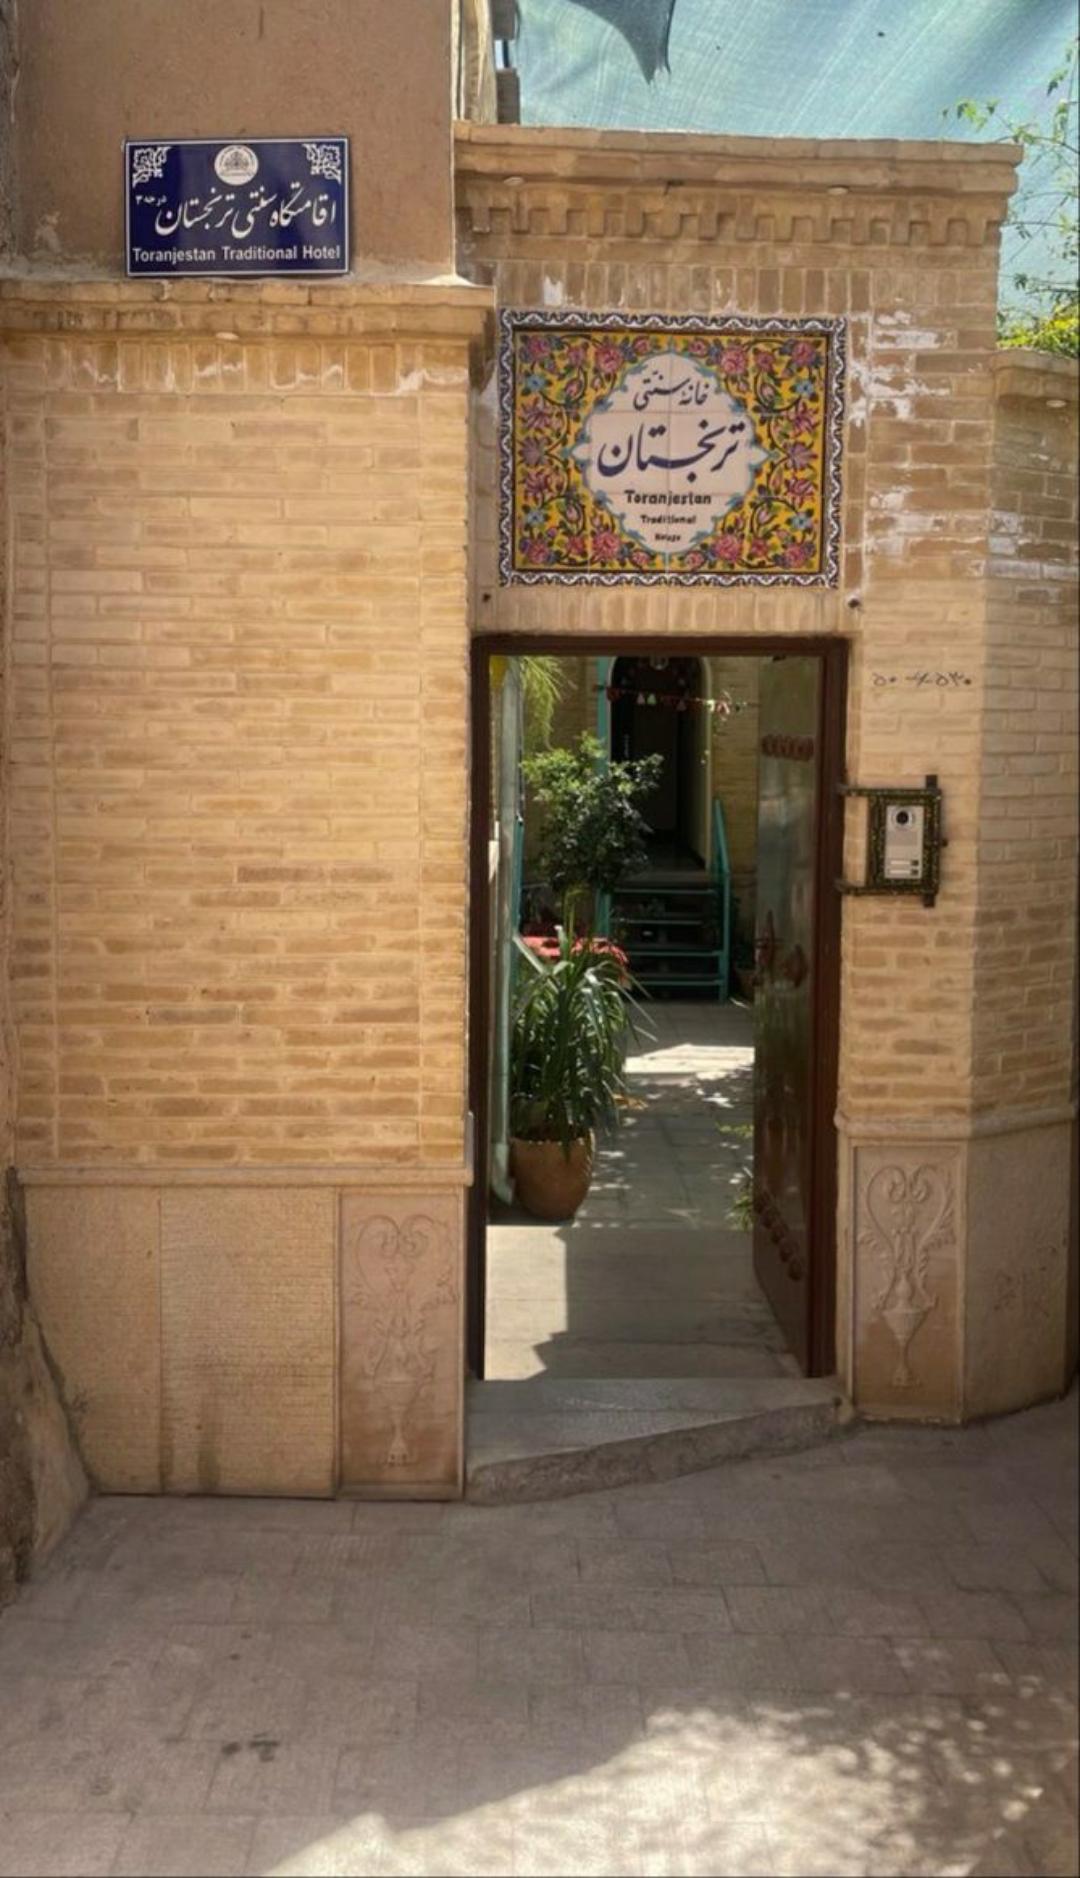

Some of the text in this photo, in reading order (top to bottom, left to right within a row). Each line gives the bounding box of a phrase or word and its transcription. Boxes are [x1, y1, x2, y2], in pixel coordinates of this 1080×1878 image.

[155, 187, 235, 236] ترنجستان
[231, 186, 278, 239] سنتی
[132, 245, 341, 265] Toranjestan Traditional Hotel
[632, 370, 691, 411] سنتی
[597, 419, 746, 483] ترنجستان
[624, 489, 712, 505] Toranjestan
[640, 514, 697, 524] Traditional
